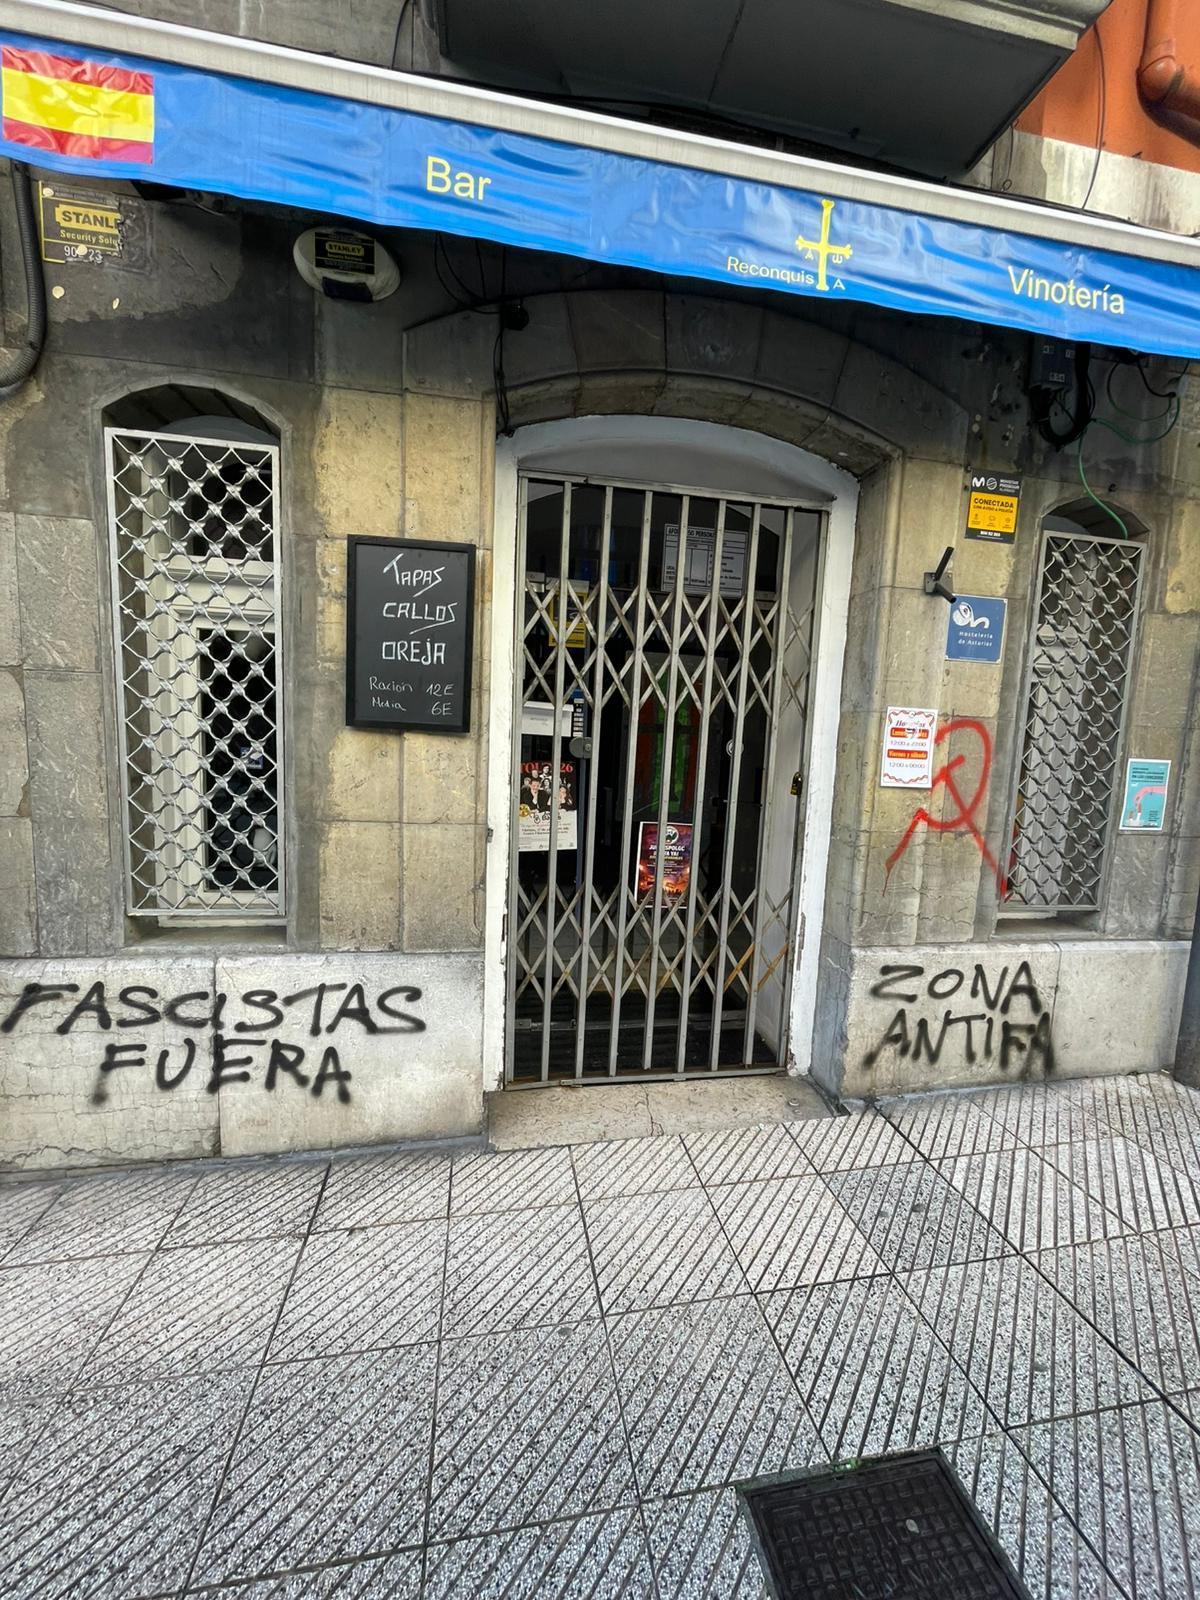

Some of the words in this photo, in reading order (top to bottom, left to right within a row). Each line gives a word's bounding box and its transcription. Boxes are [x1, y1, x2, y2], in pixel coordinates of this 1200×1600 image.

[426, 155, 492, 200] Bar
[60, 229, 97, 243] Security
[1007, 265, 1125, 315] Vinotería
[973, 498, 1014, 508] CONECTADA
[383, 553, 446, 598] TAPAS
[382, 602, 458, 635] CALLOS
[0, 981, 427, 1036] FASCISTAS
[868, 960, 1042, 1015] ZONA
[91, 1033, 353, 1105] FUERA
[861, 1007, 1056, 1084] ANTIFA
